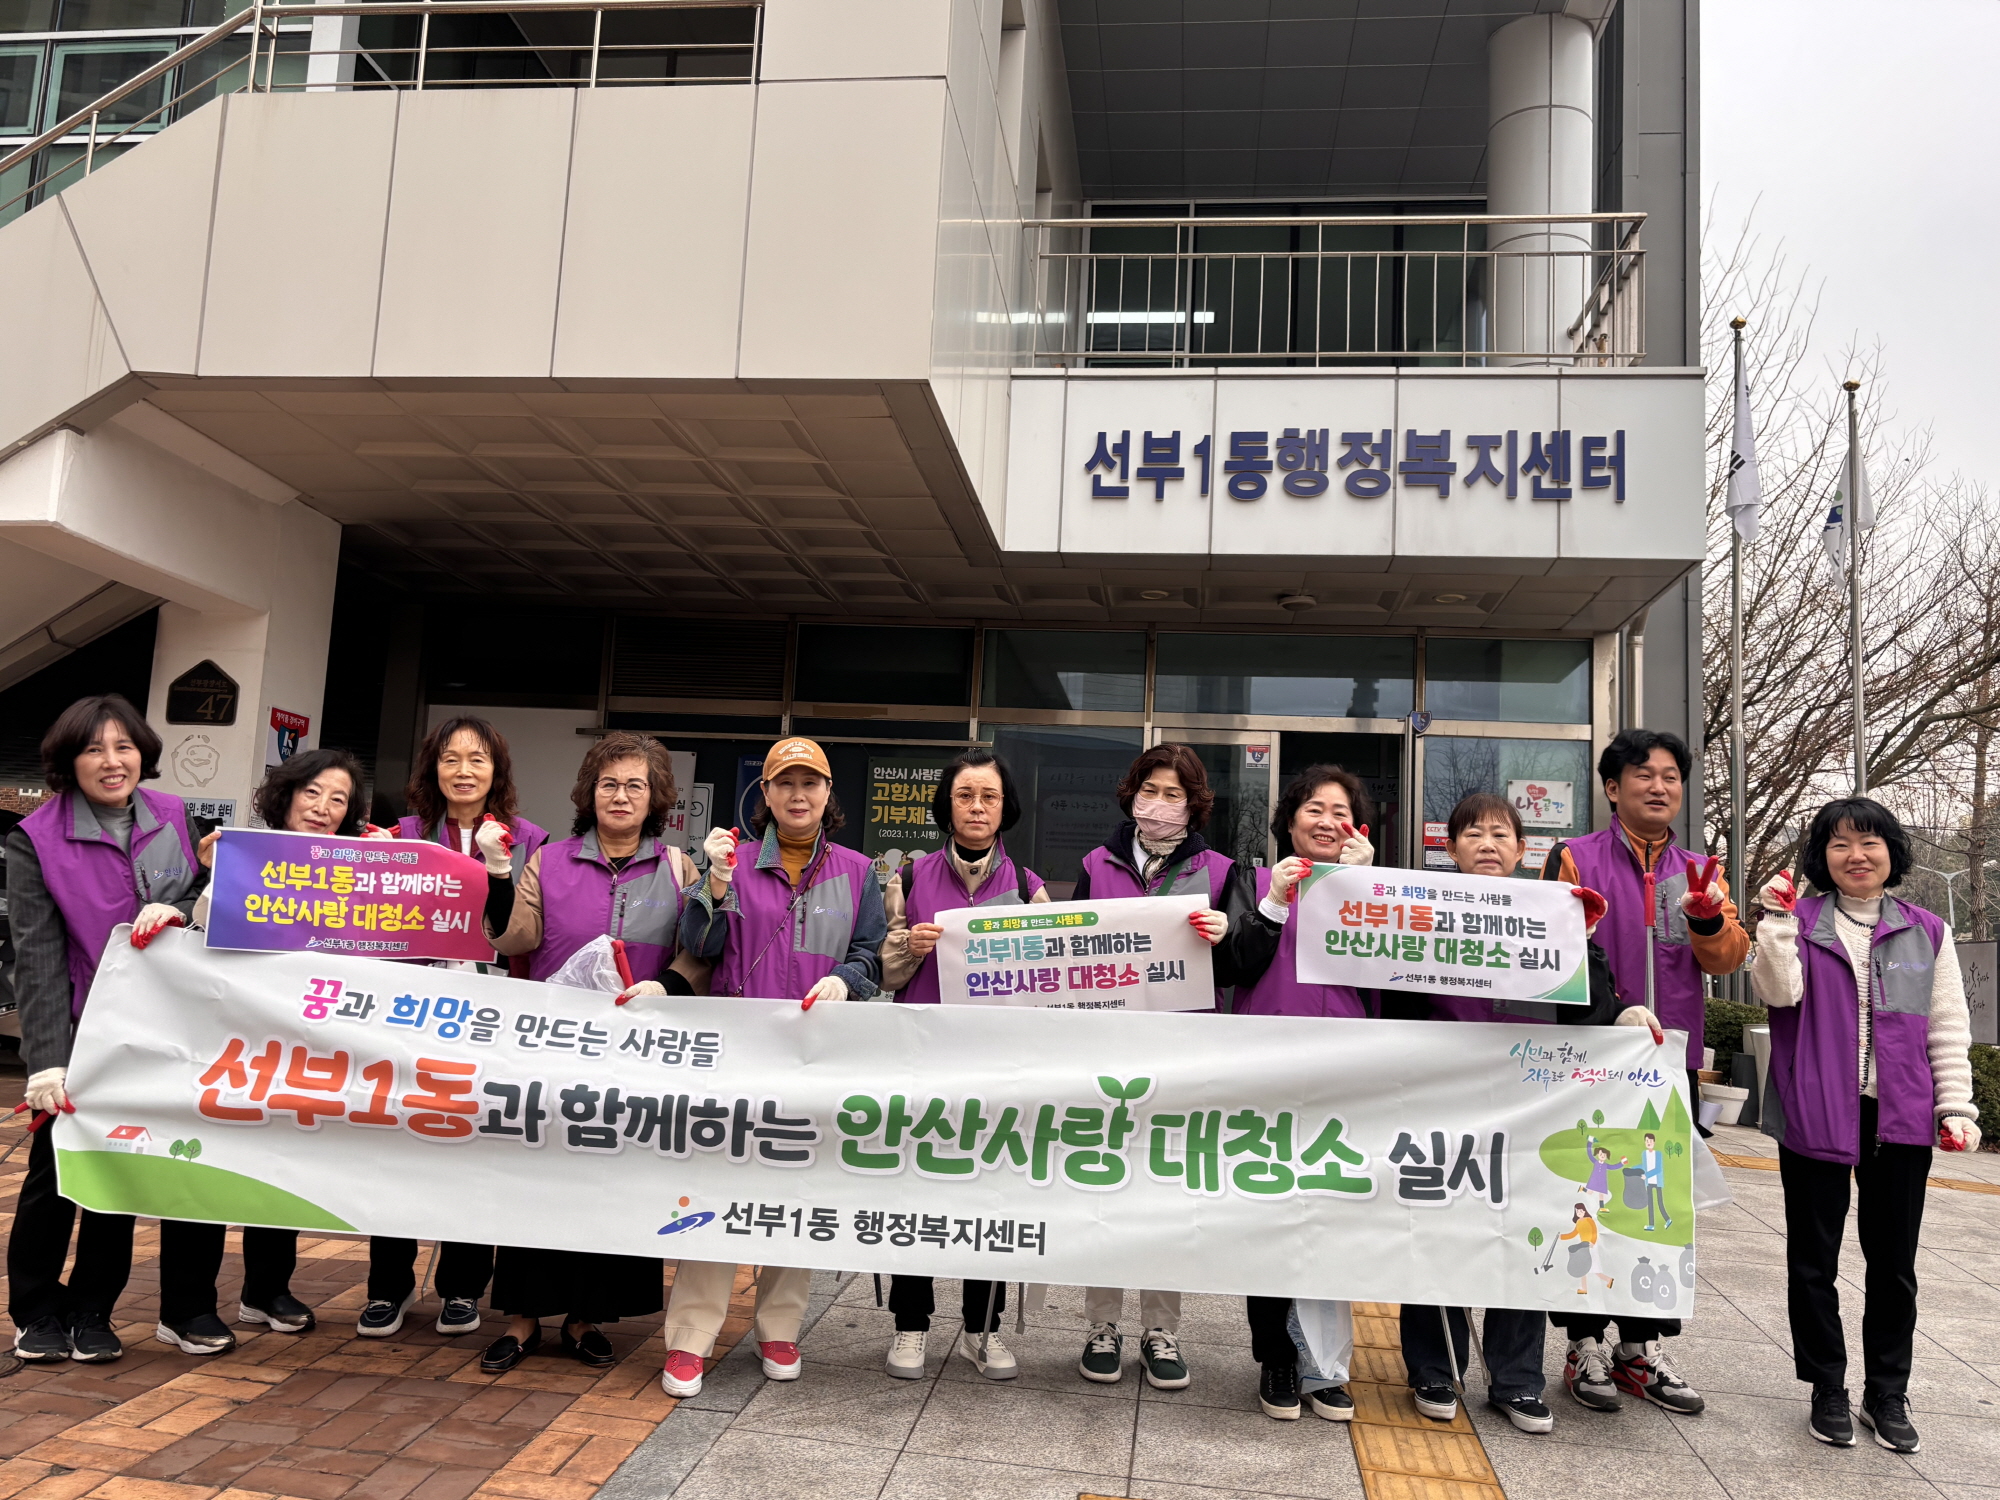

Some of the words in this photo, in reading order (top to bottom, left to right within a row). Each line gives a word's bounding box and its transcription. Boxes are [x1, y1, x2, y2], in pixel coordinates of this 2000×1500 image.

[1085, 428, 1625, 502] 선부1동행정복지센터
[196, 694, 234, 721] 47
[874, 767, 908, 780] 안산시
[218, 803, 234, 817] 쉼터
[1515, 796, 1566, 818] 나눔공간
[311, 846, 331, 859] 꿈과
[333, 848, 362, 863] 희망을
[365, 851, 390, 863] 만드는
[392, 852, 418, 864] 사람들
[260, 861, 376, 895] 선부1동과
[380, 871, 462, 897] 함께하는
[1372, 883, 1397, 897] 꿈과
[1401, 885, 1438, 900] 희망을
[1442, 891, 1475, 903] 만드는
[1479, 892, 1512, 906] 사람들
[244, 894, 348, 928] 안산사랑
[353, 903, 425, 931] 대청소
[430, 909, 471, 933] 실시
[983, 920, 1000, 931] 꿈과
[1003, 918, 1028, 929] 희망을
[1031, 917, 1053, 928] 만드는
[1056, 914, 1083, 926] 사람들
[1338, 900, 1455, 932] 선부1동과
[1461, 912, 1546, 939] 함께하는
[323, 938, 354, 950] 선부1동
[357, 940, 409, 951] 행정복지센터
[964, 934, 1065, 964] 선부1동과
[1070, 933, 1152, 957] 함께하는
[1325, 930, 1426, 962] 안산사랑
[1433, 938, 1511, 969] 대청소
[1518, 946, 1561, 971] 실시
[966, 967, 1061, 996] 안산사랑
[1068, 963, 1139, 990] 대청소
[1146, 960, 1186, 983] 실시
[1405, 973, 1436, 984] 선부1동
[1439, 975, 1492, 988] 행정복지센터
[302, 978, 377, 1020] 꿈과
[386, 992, 502, 1043] 희망을
[515, 1013, 608, 1057] 만드는
[618, 1025, 721, 1068] 사람들
[1510, 1038, 1556, 1068] 시민과
[1522, 1068, 1565, 1092] 자유로운
[1571, 1068, 1624, 1087] 혁신도시
[1628, 1067, 1667, 1088] 안산
[198, 1037, 547, 1143] 선부1동과
[561, 1081, 817, 1163] 함께하는
[837, 1094, 1134, 1186] 안산사랑
[1149, 1109, 1372, 1194] 대청소
[1389, 1130, 1505, 1204] 실시
[721, 1202, 840, 1242] 선부1동
[853, 1209, 1046, 1255] 행정복지센터
